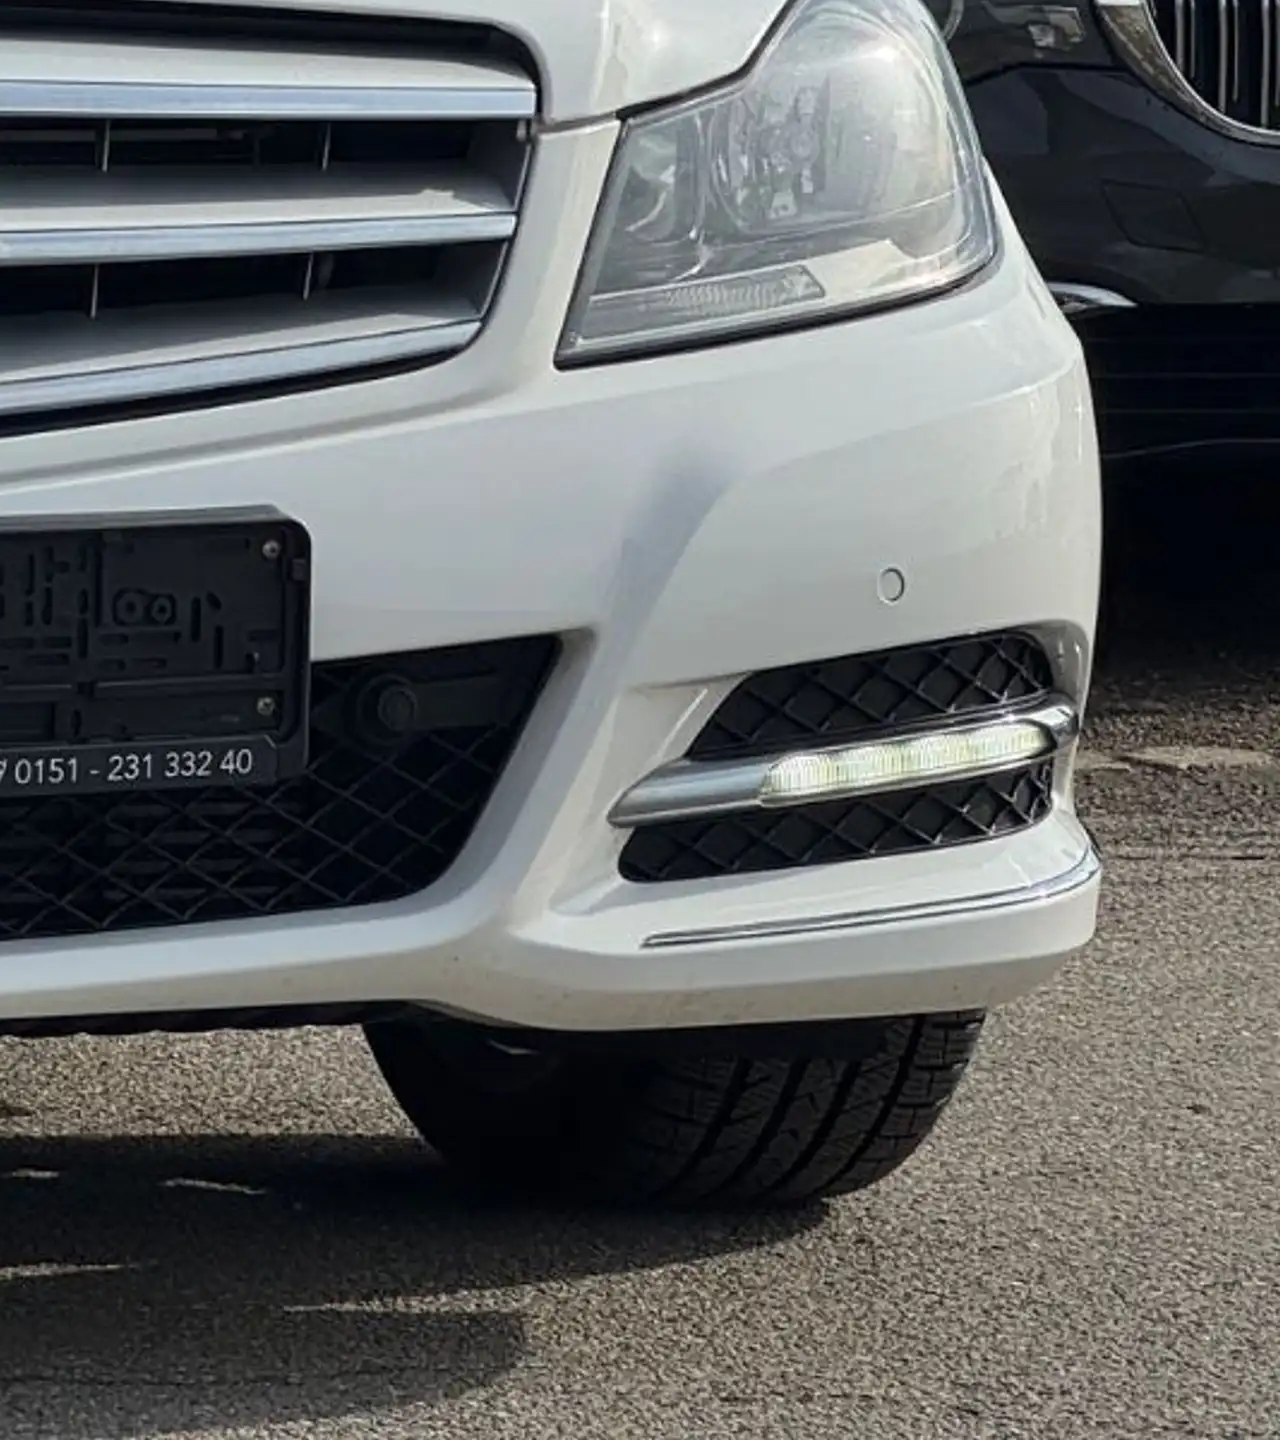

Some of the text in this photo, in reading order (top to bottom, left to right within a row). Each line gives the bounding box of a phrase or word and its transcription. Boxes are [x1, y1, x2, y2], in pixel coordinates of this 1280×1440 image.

[13, 758, 79, 785] 0151
[106, 753, 153, 782] 231
[164, 750, 213, 778] 332
[219, 748, 254, 774] 40
